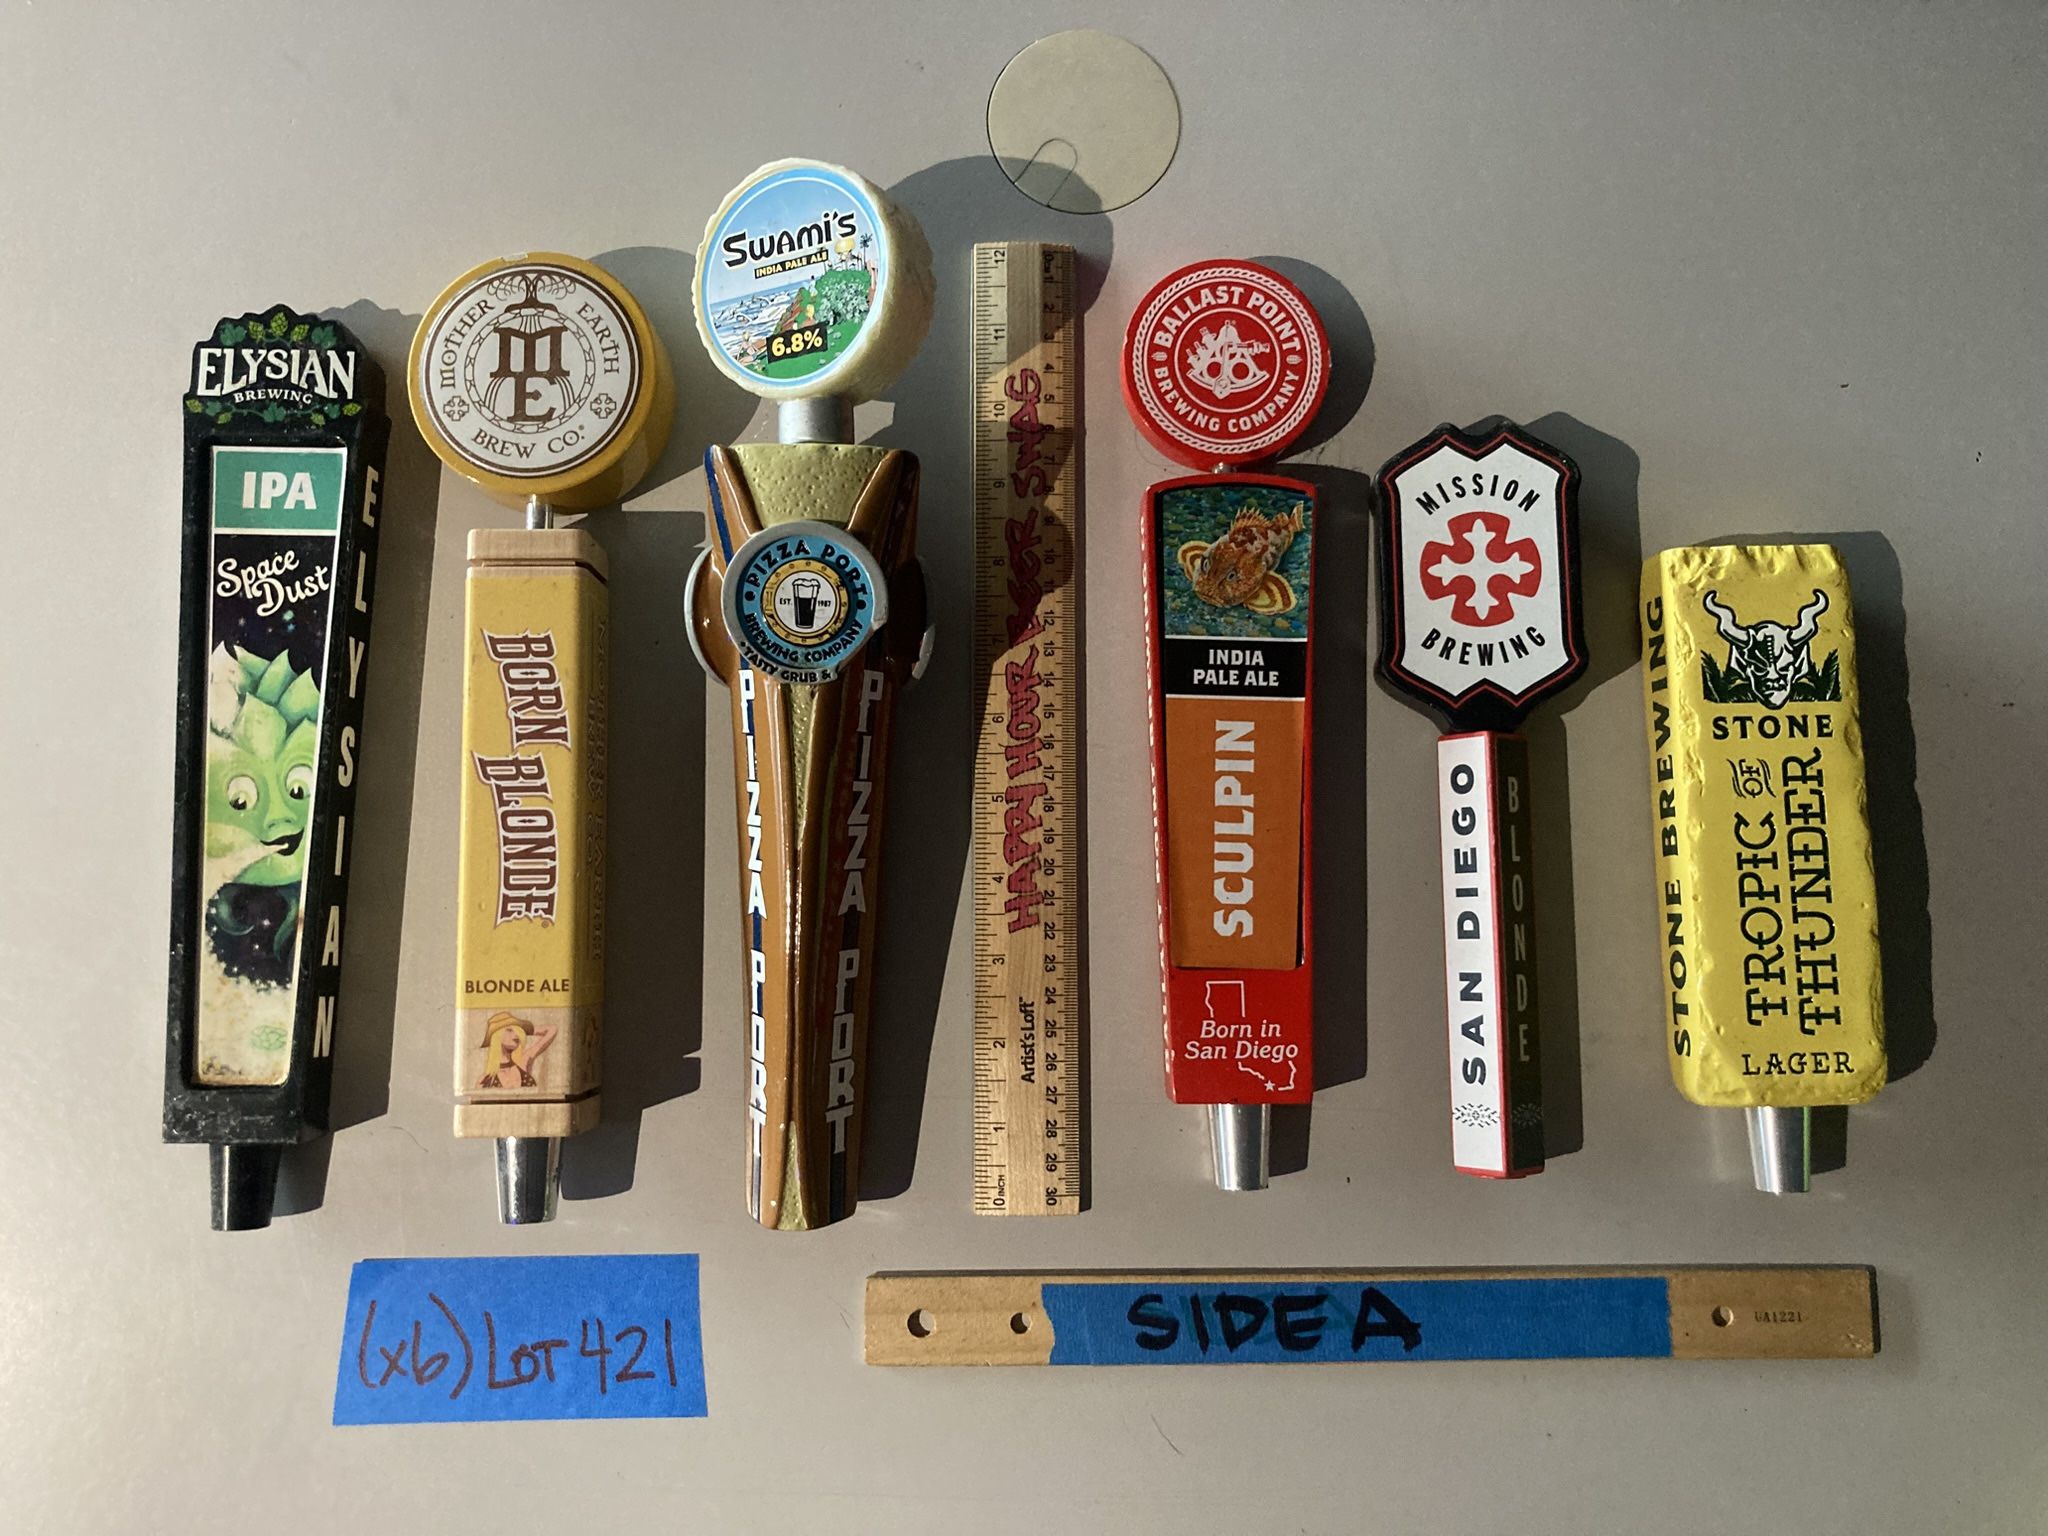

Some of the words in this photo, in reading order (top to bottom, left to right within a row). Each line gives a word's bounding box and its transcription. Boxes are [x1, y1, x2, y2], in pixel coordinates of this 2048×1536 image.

[723, 211, 856, 267] Swami's
[755, 264, 782, 278] INDIA
[785, 257, 808, 271] PALE
[810, 251, 828, 265] ALE
[993, 250, 1006, 264] 12
[993, 328, 1006, 341] 11
[1153, 286, 1245, 348] BALLAST
[1246, 291, 1301, 351] POINT
[440, 299, 495, 390] MOTHER
[576, 301, 620, 375] EARTH
[771, 328, 822, 357] 6.8%
[197, 348, 356, 399] ELYSIAN
[233, 388, 313, 404] BREWING
[993, 403, 1006, 418] 10
[1154, 367, 1220, 432] BREWING
[1228, 370, 1300, 433] COMPANY
[471, 428, 537, 460] BREW
[242, 471, 317, 509] IPA
[1415, 473, 1541, 515] MISSION
[216, 550, 299, 599] Space
[747, 540, 810, 587] PIZZA
[821, 543, 867, 596] PORT
[252, 565, 330, 617] Dust
[1043, 609, 1055, 626] 12
[744, 613, 799, 663] BREWING
[804, 620, 863, 664] COMPANY
[1043, 641, 1055, 657] 13
[1420, 626, 1546, 667] BREWING
[744, 645, 779, 676] TASTY
[780, 669, 818, 684] GRUB
[820, 668, 832, 680] &
[1208, 649, 1265, 666] INDIA
[480, 628, 571, 753] BORN
[1043, 672, 1055, 688] 14
[1193, 669, 1239, 685] PALE
[1244, 671, 1279, 687] ALE
[1005, 643, 1046, 779] HOUR
[1043, 702, 1055, 719] 15
[1647, 596, 1679, 857] BREWING
[1712, 714, 1833, 740] STONE
[1043, 734, 1055, 750] 16
[313, 465, 379, 1059] ELYSIAN
[1043, 765, 1055, 781] 17
[1739, 759, 1764, 798] OF
[737, 669, 768, 919] PIZZA
[837, 669, 887, 918] PIZZA
[1043, 796, 1055, 813] 18
[1043, 828, 1055, 845] 19
[1213, 720, 1255, 938] SCULPIN
[1003, 782, 1048, 934] HAPPY
[1043, 858, 1055, 876] 20
[1450, 764, 1480, 941] DIEGO
[1043, 890, 1055, 907] 21
[1782, 747, 1842, 1036] THUNDER
[1043, 922, 1055, 940] 22
[1508, 776, 1531, 1063] BLONDE
[1734, 811, 1789, 1026] TROPIC
[1044, 954, 1056, 973] 23
[1665, 879, 1691, 1057] STONE
[464, 979, 536, 994] BLONDE
[540, 979, 571, 993] ALE
[1044, 986, 1056, 1005] 24
[1019, 997, 1035, 1031] Loft
[1044, 1019, 1056, 1038] 25
[1200, 1020, 1252, 1039] Born
[1261, 1020, 1281, 1038] in
[1458, 971, 1487, 1086] SAN
[749, 948, 768, 1158] PORT
[825, 948, 861, 1156] PORT
[1020, 1032, 1035, 1083] Artist's
[1046, 1053, 1057, 1071] 26
[1184, 1041, 1227, 1059] San
[1235, 1040, 1299, 1063] Diego
[1742, 1051, 1855, 1076] LAGER
[1046, 1086, 1057, 1105] 27
[1046, 1119, 1057, 1138] 28
[1046, 1153, 1057, 1172] 29
[993, 1198, 1005, 1206] 0
[1046, 1187, 1057, 1206] 30
[1127, 1290, 1329, 1355] SIDE
[1352, 1286, 1421, 1353] A
[580, 1317, 677, 1395] 421
